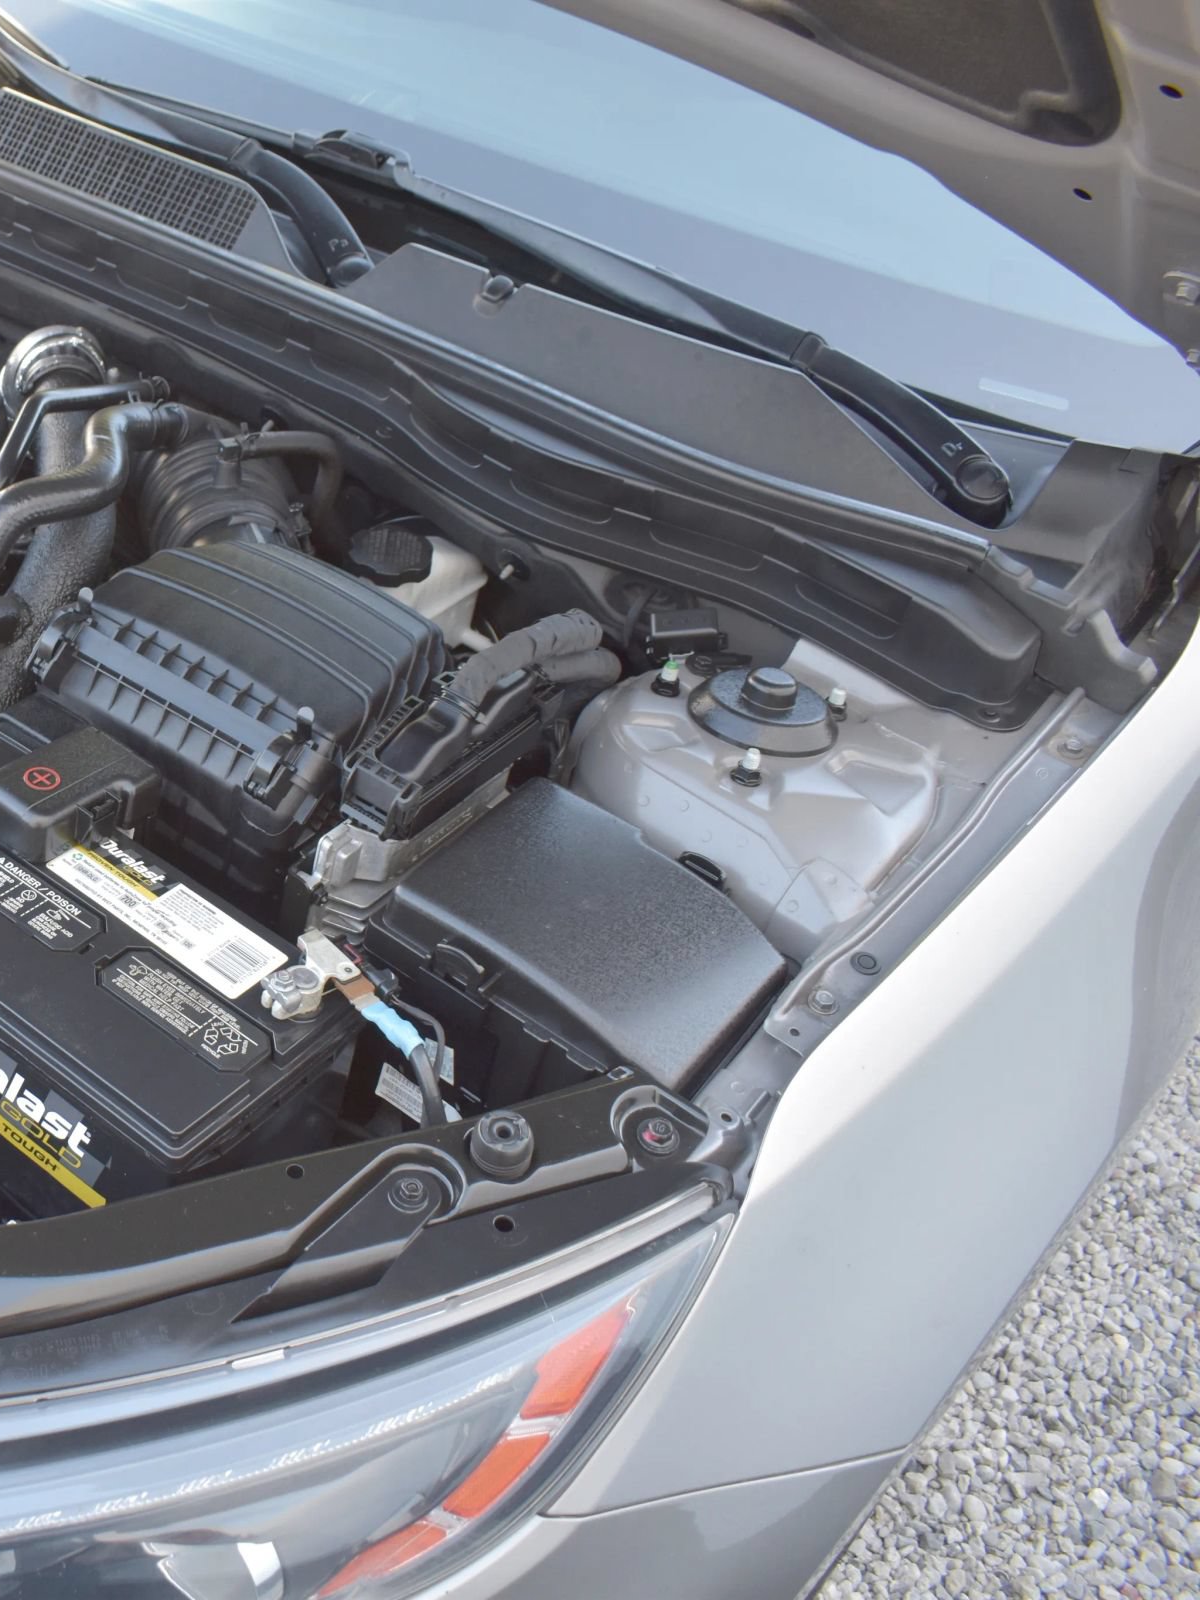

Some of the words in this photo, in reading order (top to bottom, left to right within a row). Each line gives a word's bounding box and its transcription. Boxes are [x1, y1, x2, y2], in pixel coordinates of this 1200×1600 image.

[87, 852, 114, 871] PROVEN
[115, 870, 138, 887] TOUGH
[100, 840, 166, 883] Duralast
[4, 862, 41, 888] DANGER
[46, 890, 82, 917] POISON
[120, 895, 137, 907] 700
[0, 1100, 82, 1168] GOLD
[2, 1122, 58, 1171] TOUGH
